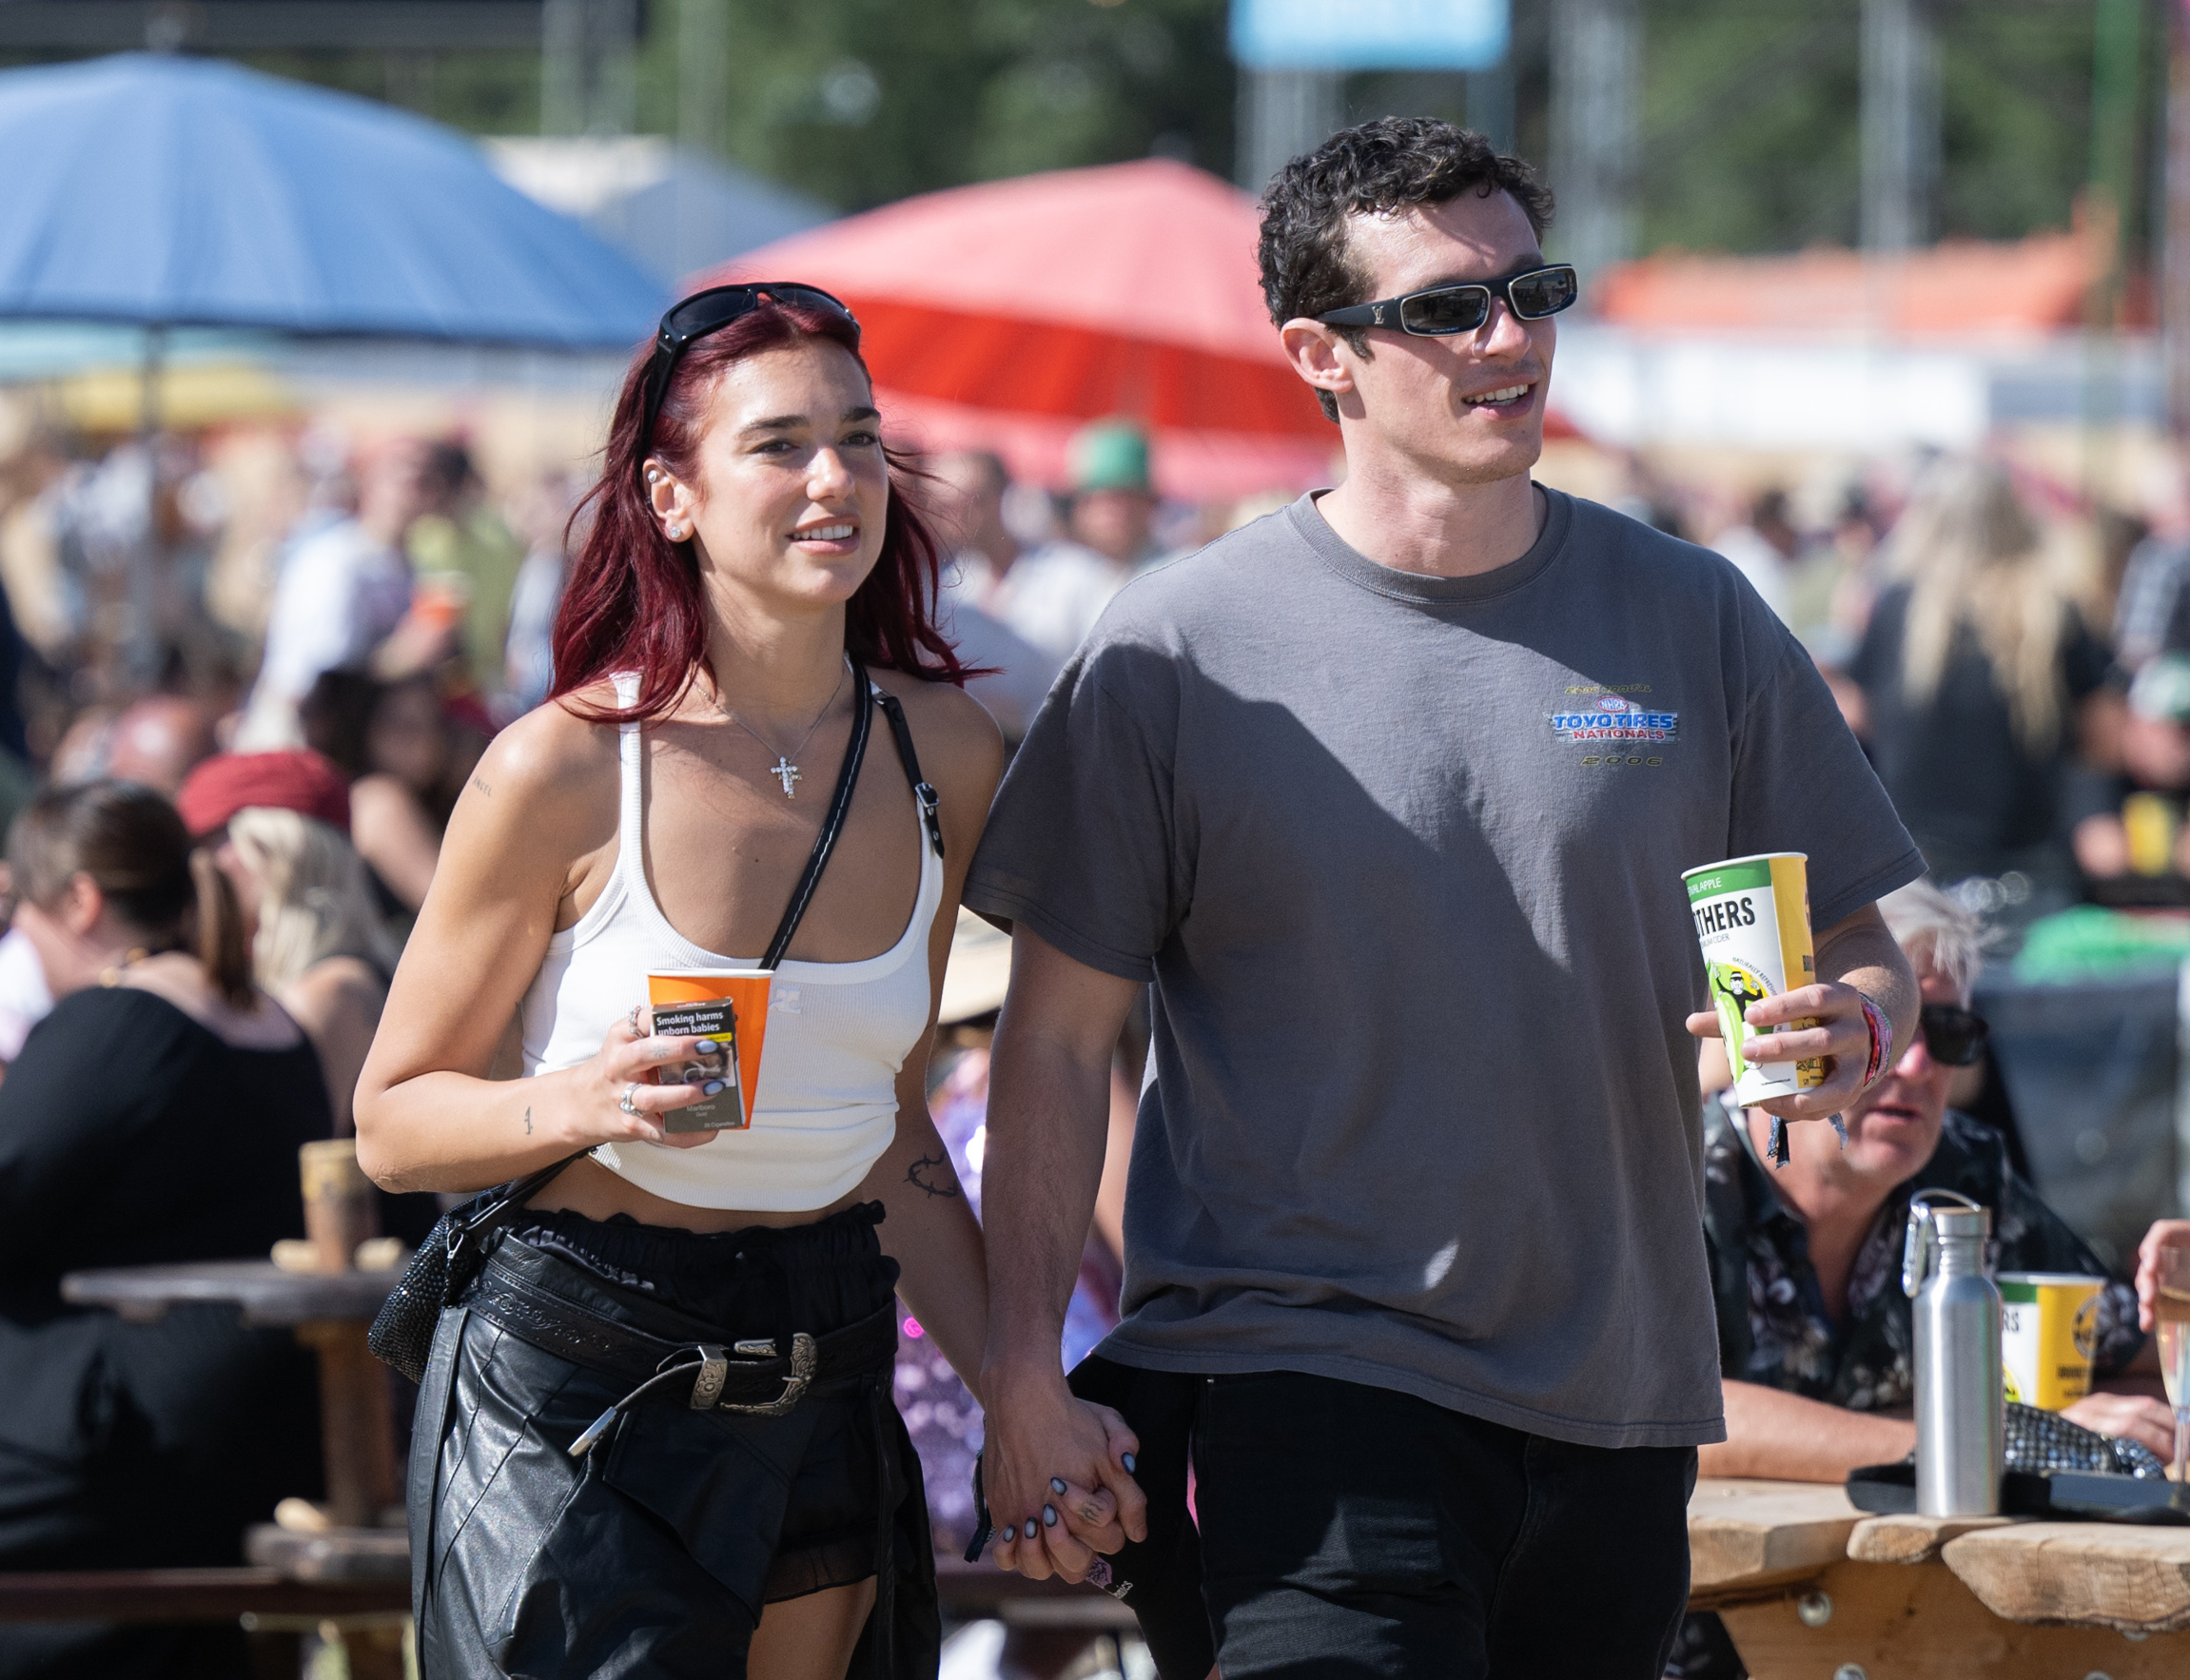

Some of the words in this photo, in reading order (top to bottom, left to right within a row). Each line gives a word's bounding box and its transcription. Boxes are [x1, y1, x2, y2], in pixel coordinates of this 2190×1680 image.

[1553, 713, 1612, 730] TOYO
[1614, 713, 1674, 730] TIRES
[1572, 729, 1666, 740] NATIONALS
[1580, 756, 1663, 767] 2006
[1699, 876, 1723, 891] APPLE
[656, 1014, 694, 1026] Smoking
[695, 1011, 723, 1023] harms
[658, 1026, 690, 1036] unborn
[691, 1023, 720, 1034] babies
